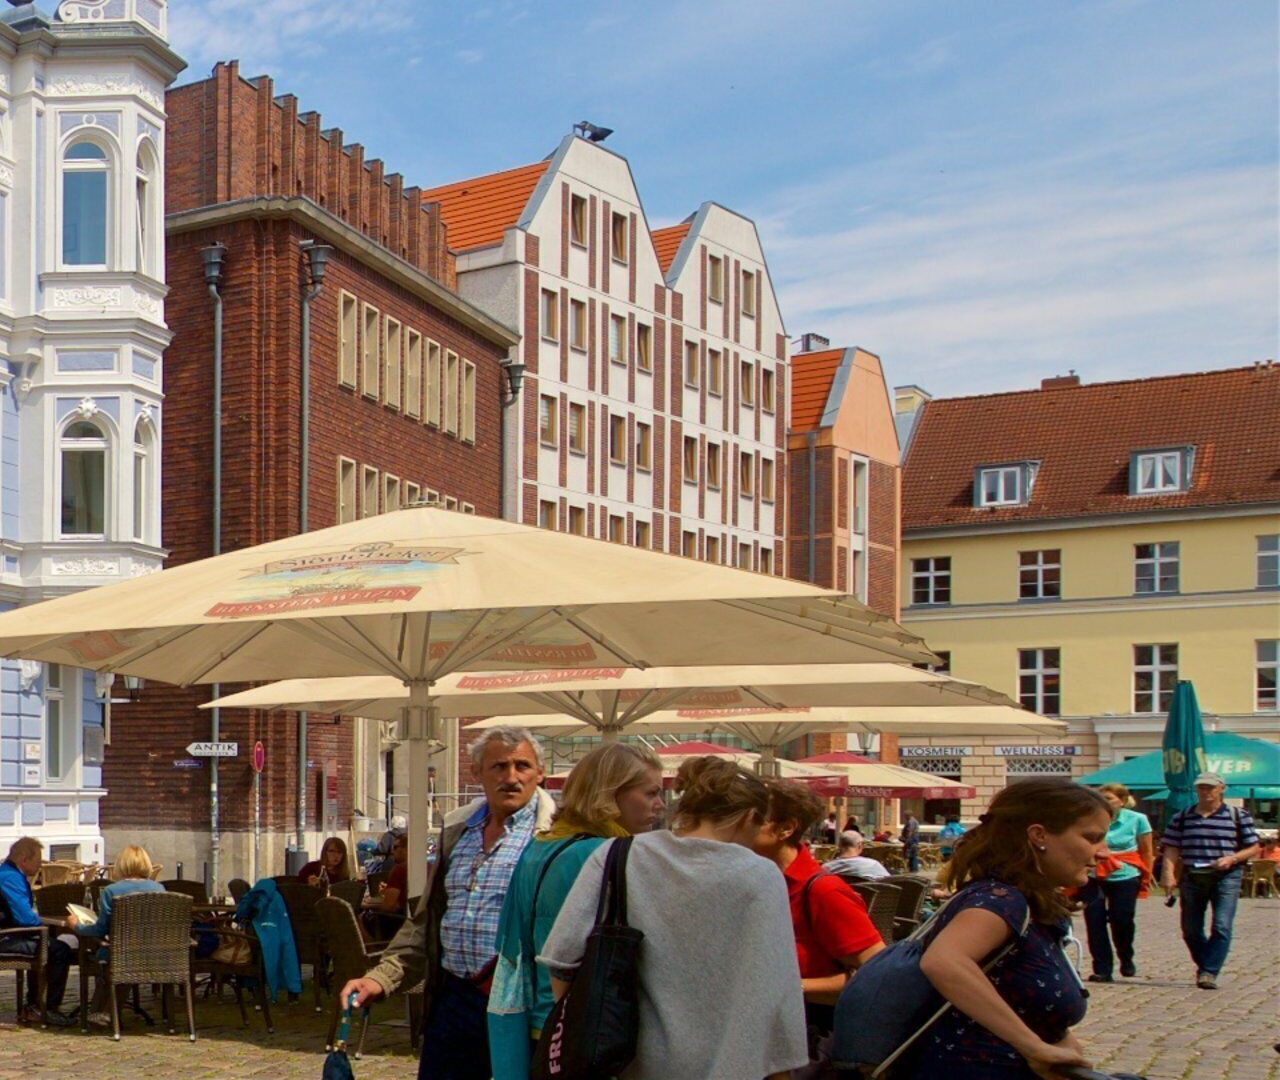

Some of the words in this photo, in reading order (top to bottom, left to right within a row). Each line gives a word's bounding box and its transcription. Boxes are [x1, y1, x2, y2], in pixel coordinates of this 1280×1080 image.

[194, 743, 237, 751] ANTIK
[907, 747, 967, 757] KOSMETIK
[1001, 746, 1063, 756] WELLNESS
